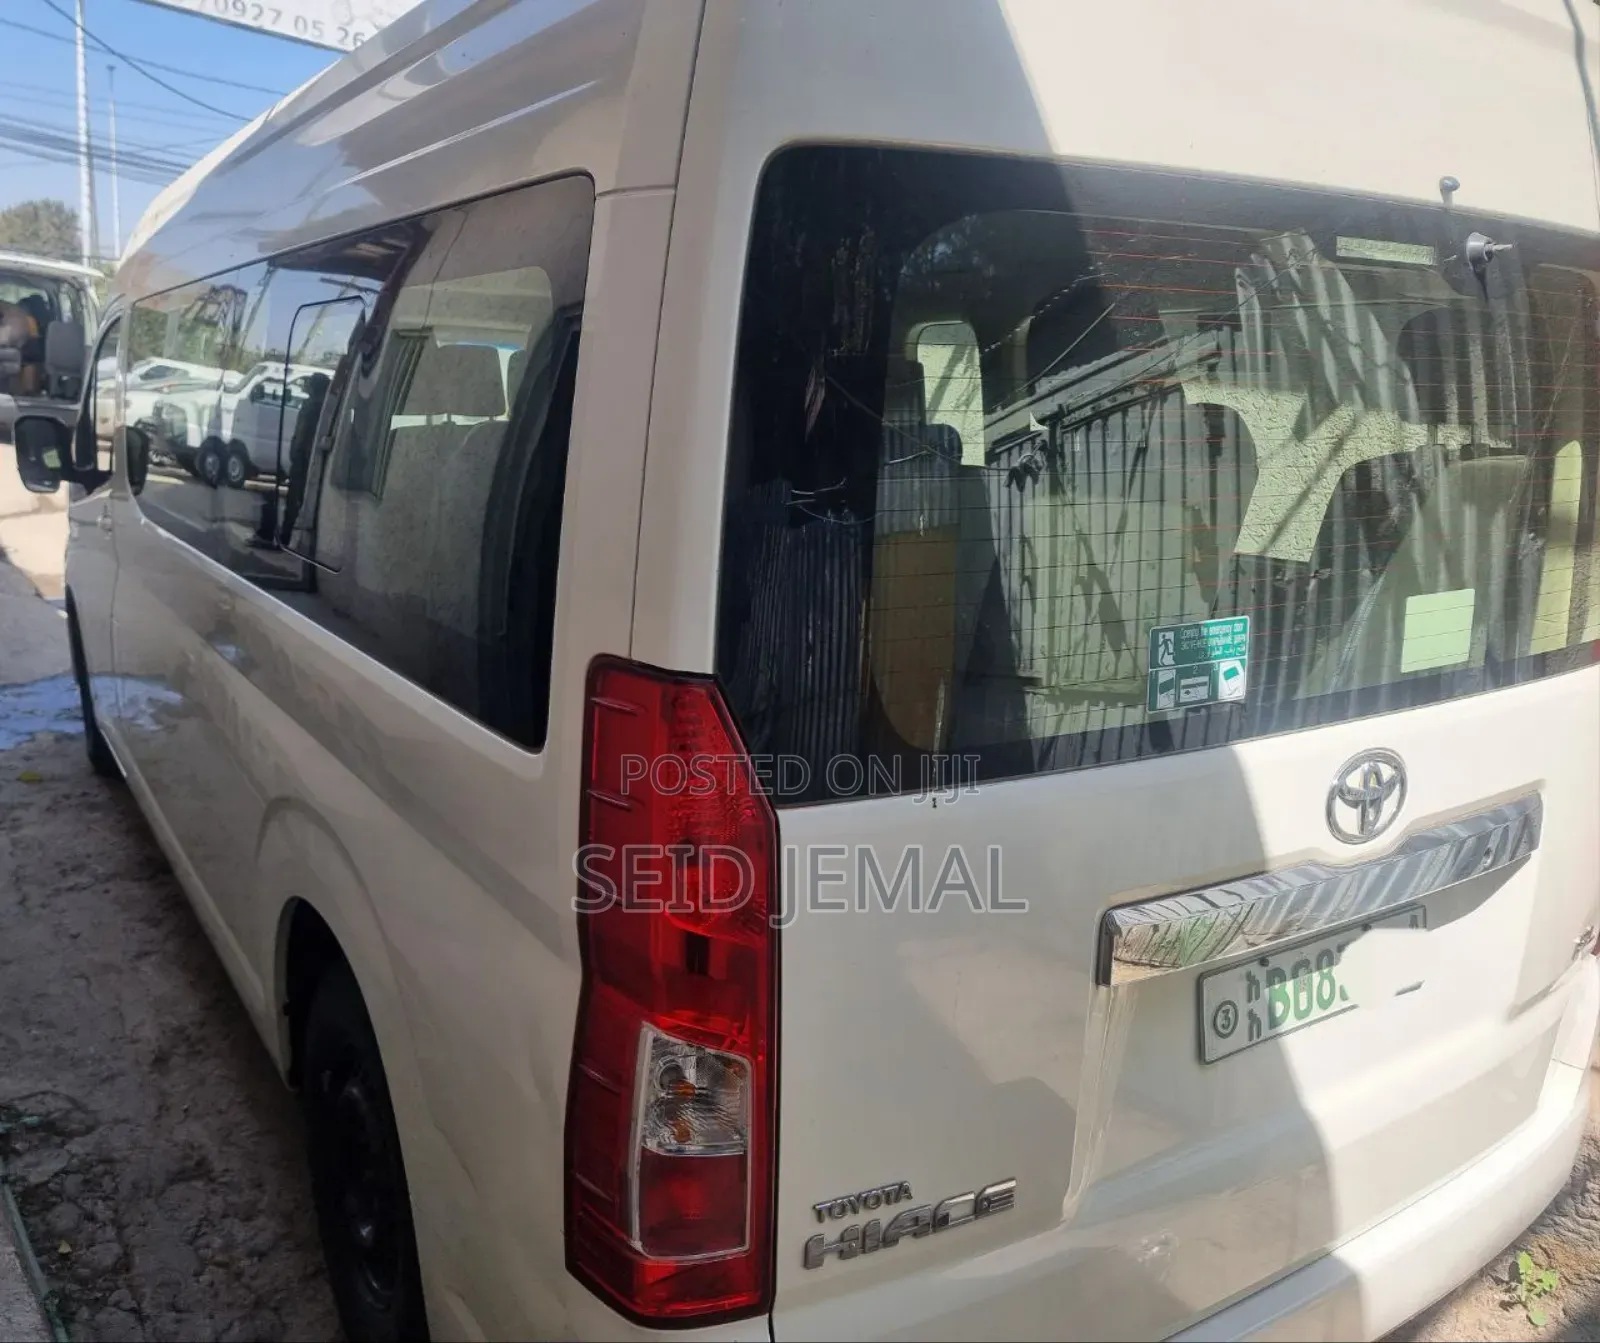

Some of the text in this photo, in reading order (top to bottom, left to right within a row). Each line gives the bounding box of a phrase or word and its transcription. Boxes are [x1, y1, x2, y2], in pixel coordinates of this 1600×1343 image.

[294, 15, 325, 40] 05
[1266, 944, 1349, 1030] B08
[803, 1176, 1018, 1270] HIACE
[812, 1180, 914, 1224] TOYOTA
